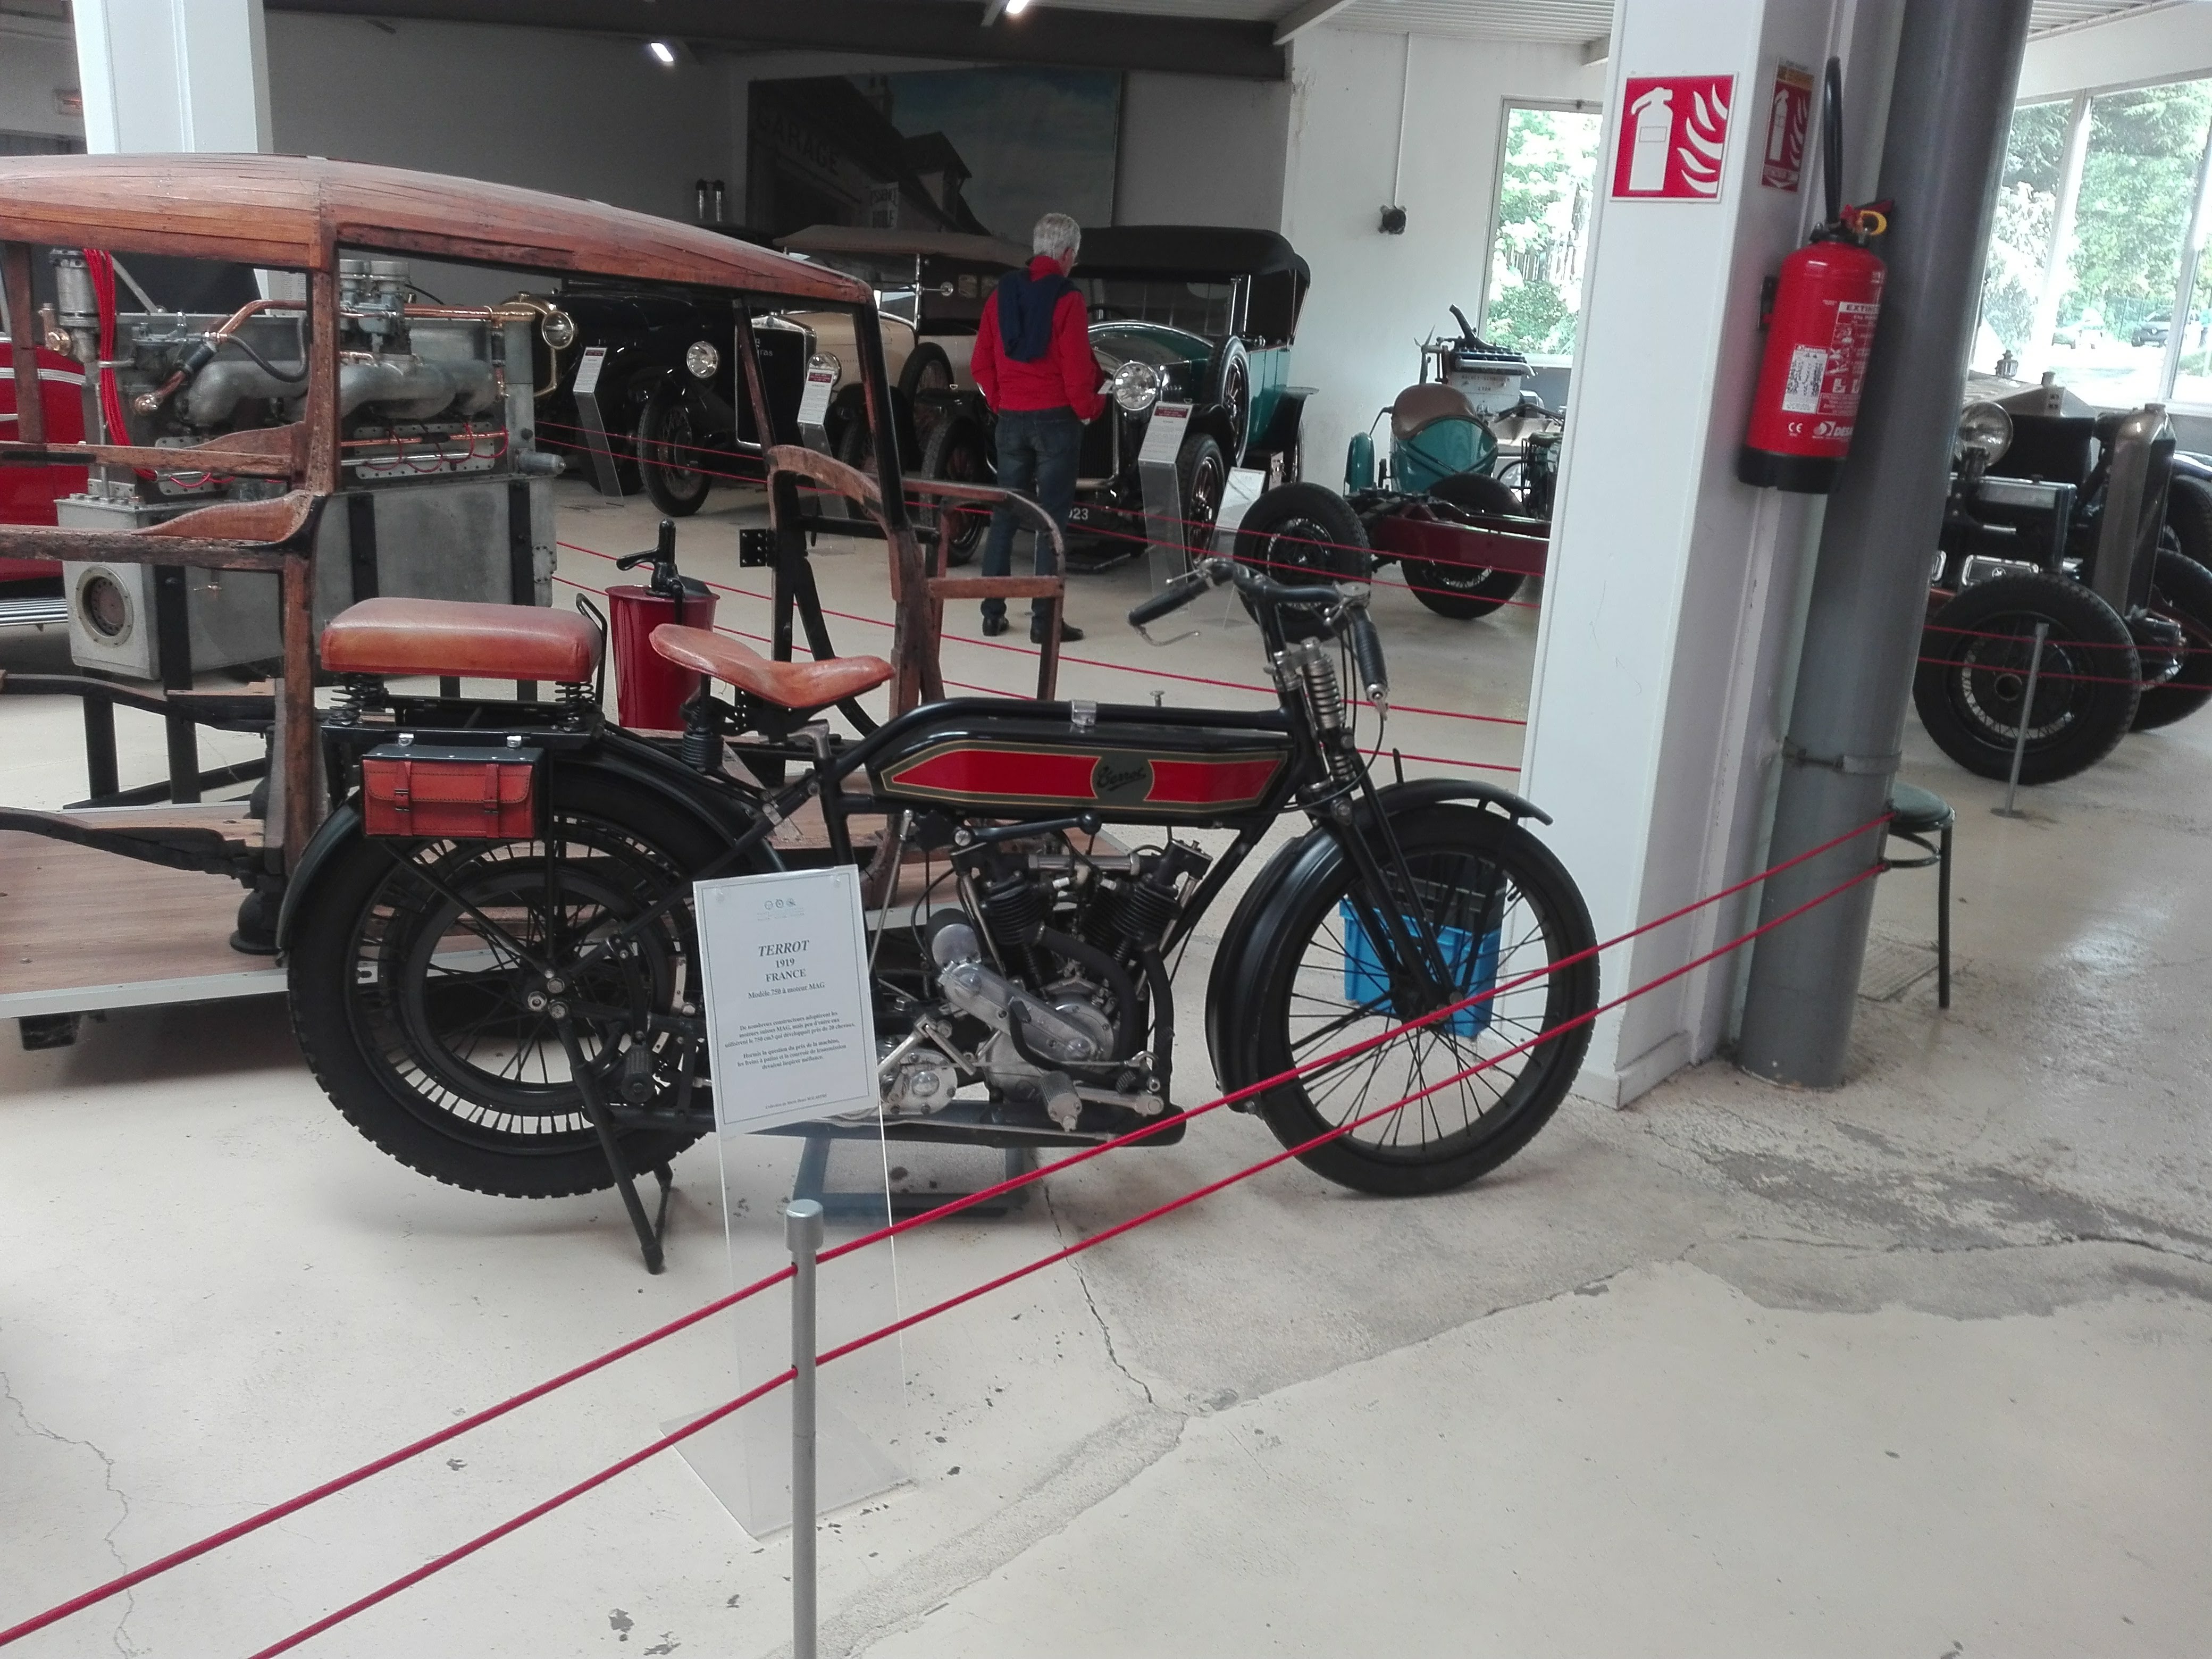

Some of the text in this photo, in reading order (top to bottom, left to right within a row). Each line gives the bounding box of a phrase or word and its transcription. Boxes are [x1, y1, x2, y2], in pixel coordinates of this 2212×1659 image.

[757, 111, 839, 176] GARAGE
[758, 940, 810, 957] TERROT
[775, 958, 795, 968] 1919
[766, 968, 807, 982] FRANCE
[748, 988, 770, 999] Modèle
[809, 982, 825, 990] MAG
[817, 1044, 847, 1053] transmission
